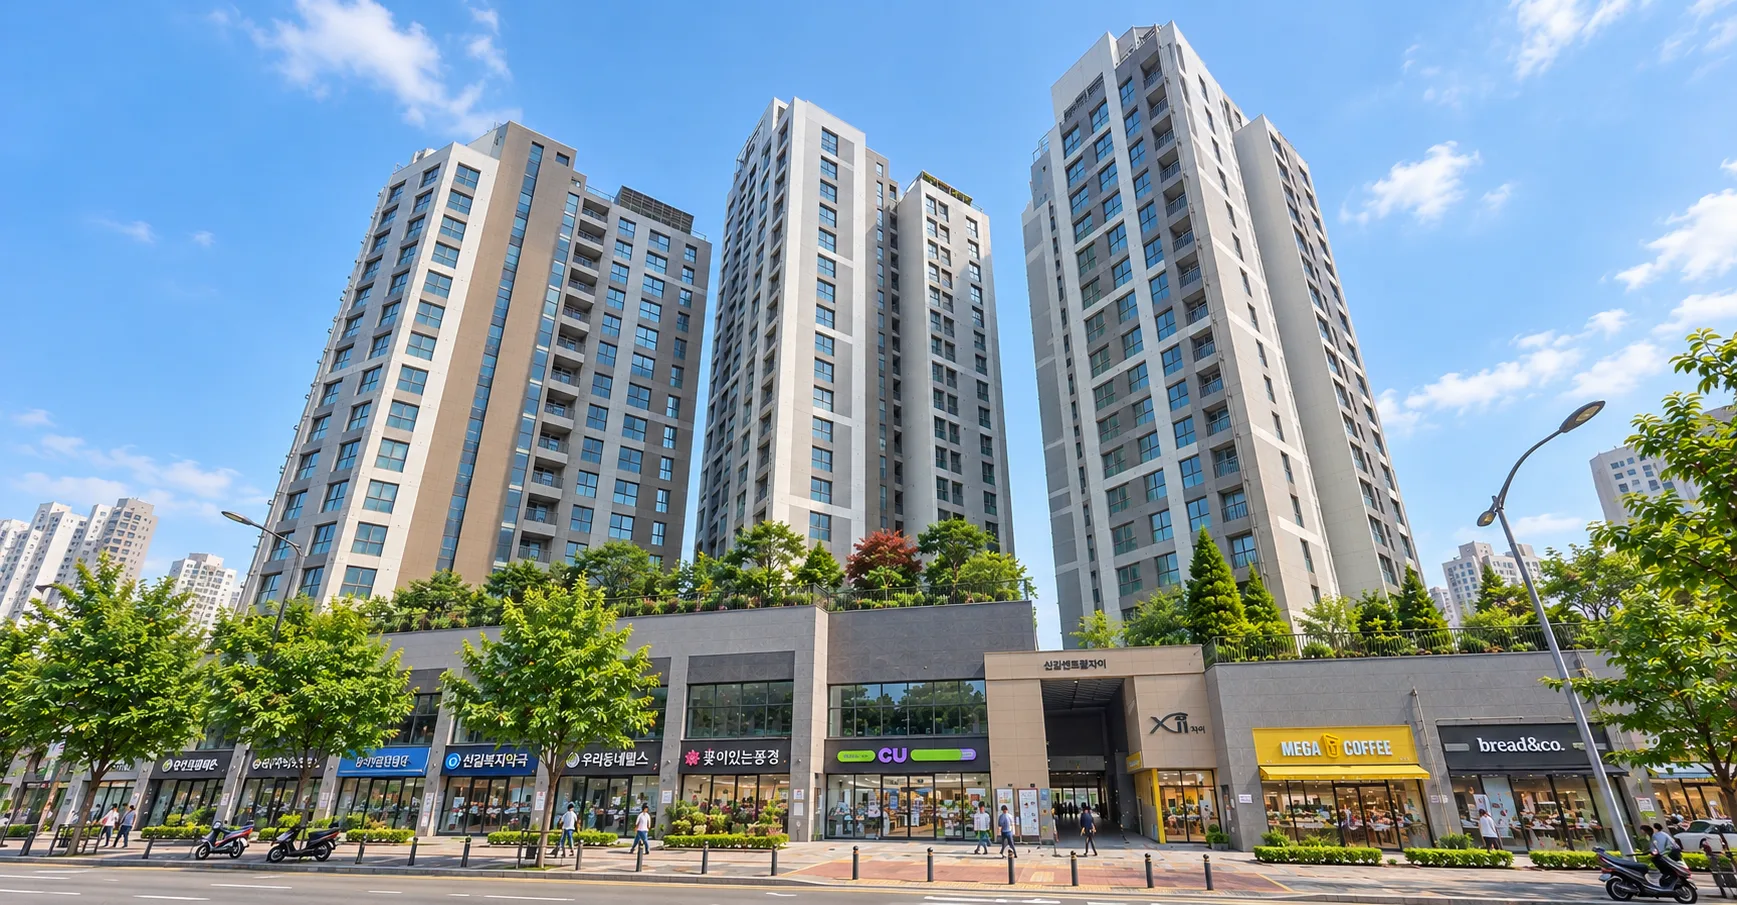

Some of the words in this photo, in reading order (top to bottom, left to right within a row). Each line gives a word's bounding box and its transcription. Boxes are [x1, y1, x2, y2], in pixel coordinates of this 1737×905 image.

[1280, 741, 1322, 757] MEGA
[1343, 740, 1393, 756] COFFEE
[1476, 736, 1566, 753] bread&co.
[877, 747, 908, 764] CU
